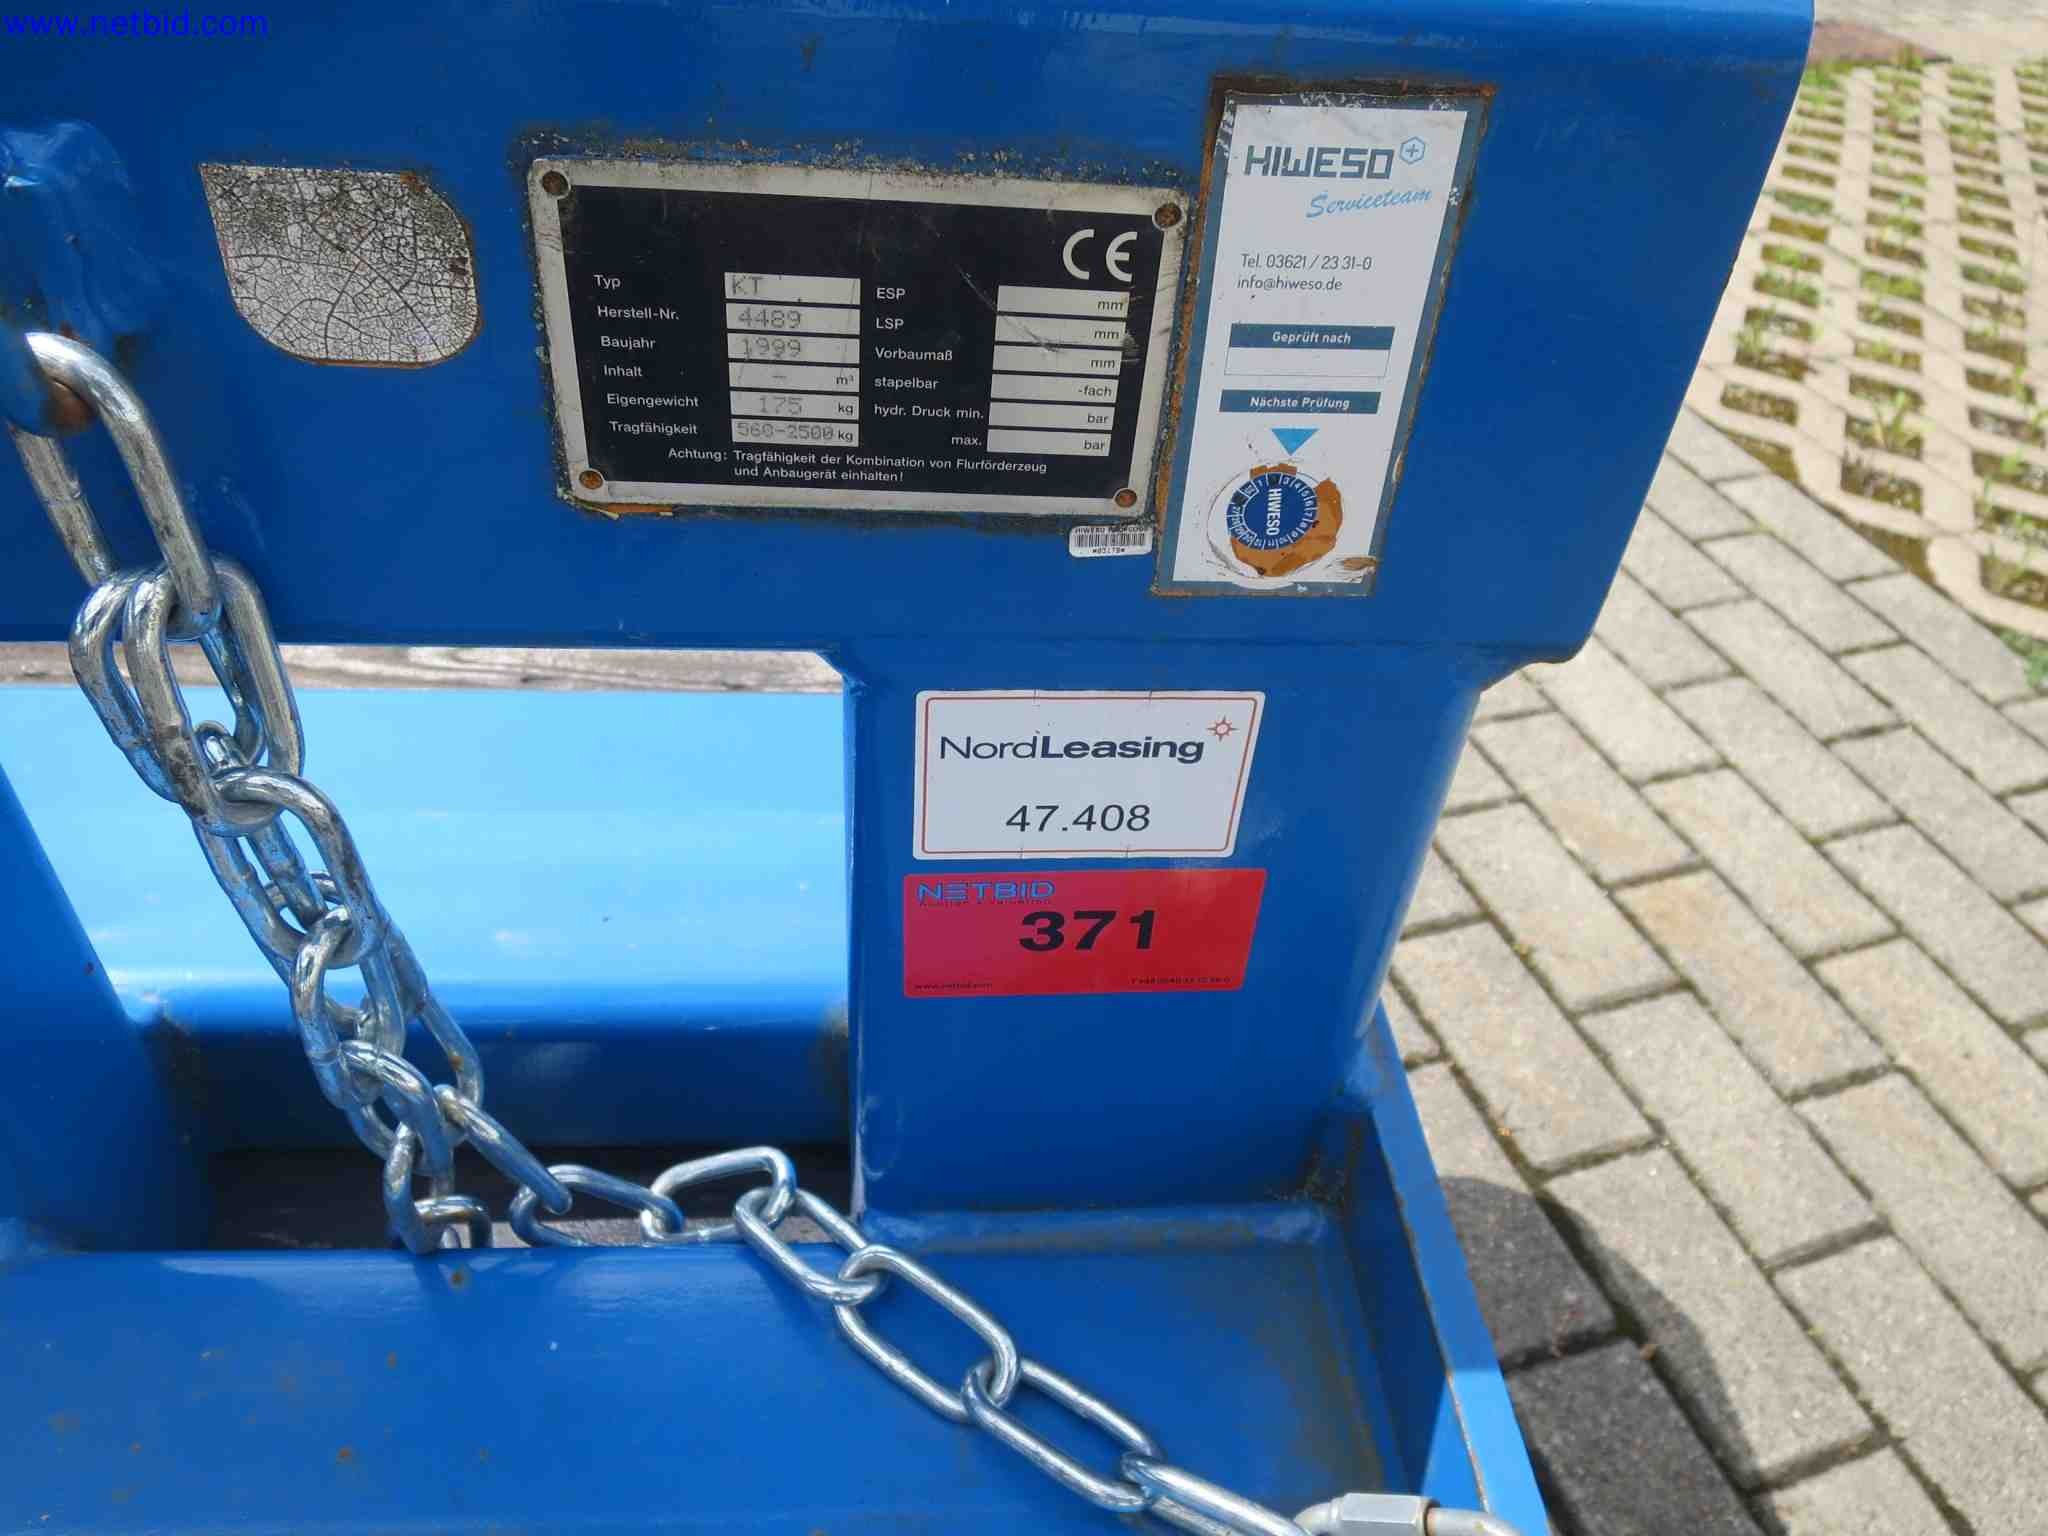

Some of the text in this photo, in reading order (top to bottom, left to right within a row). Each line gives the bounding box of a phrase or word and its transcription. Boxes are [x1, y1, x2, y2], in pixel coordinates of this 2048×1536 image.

[1244, 145, 1394, 179] HIWESO
[1306, 189, 1431, 218] Serviceteam
[1062, 229, 1138, 282] CE
[1266, 254, 1307, 269] 03621
[593, 275, 621, 290] Typ
[732, 275, 763, 295] KT
[1237, 275, 1343, 291] info@hiweso.de
[876, 288, 906, 301] ESP
[1097, 300, 1124, 311] mm
[597, 306, 680, 321] Herstell-Nr.
[738, 307, 801, 328] 4489
[876, 318, 905, 331] LSP
[1094, 329, 1120, 340] mm
[1272, 331, 1351, 345] Geprüft nach
[600, 336, 656, 350] Baujahr
[875, 348, 953, 362] Vorbaumaß
[604, 365, 642, 377] Inhalt
[1091, 358, 1116, 369] mm
[874, 377, 939, 392] stapelbar
[1078, 385, 1112, 397] -fach
[607, 394, 698, 409] Eigengewicht
[1250, 396, 1350, 410] Nächste Prüfung
[838, 403, 854, 417] kg
[874, 405, 984, 420] hydr. Druck min.
[1087, 412, 1109, 425] bar
[609, 421, 698, 436] Tragfähigkeit
[838, 429, 854, 442] kg
[951, 436, 982, 447] max.
[1083, 439, 1106, 451] bar
[668, 448, 1047, 474] Achtung: Tragfähigkeit der Kombination von Flurförderzeug
[734, 466, 903, 482] und Anbaugerät einhalten!
[1266, 488, 1282, 535] HIWESO
[940, 736, 1204, 764] NordLeasing
[1005, 804, 1150, 832] 47.408
[917, 881, 1055, 901] NETBID
[1019, 910, 1156, 952] 371
